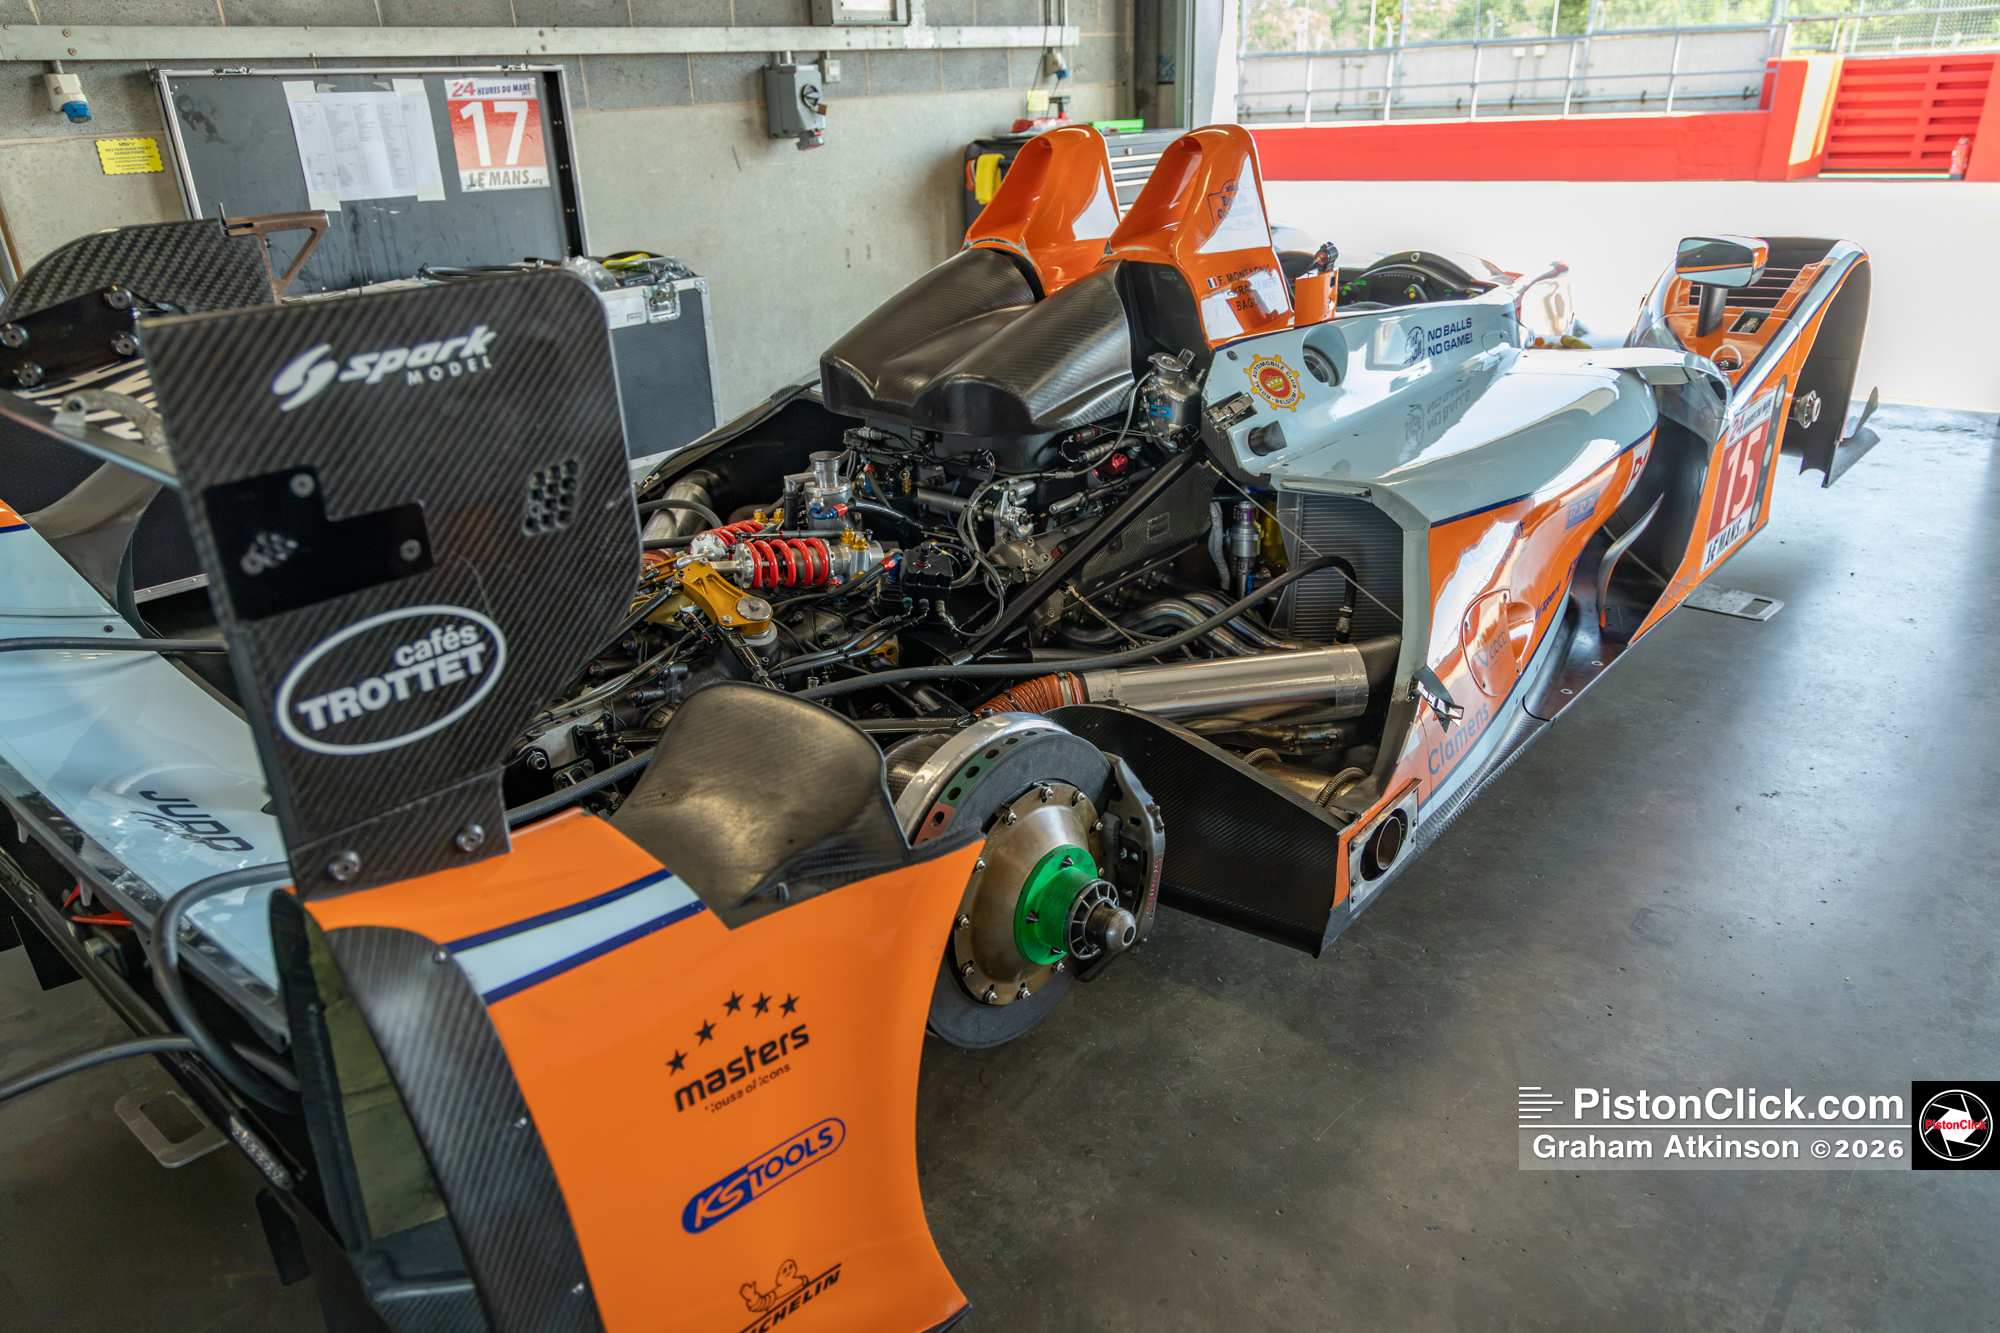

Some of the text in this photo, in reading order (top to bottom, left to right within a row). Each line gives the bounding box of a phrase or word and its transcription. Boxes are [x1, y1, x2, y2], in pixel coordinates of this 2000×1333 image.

[452, 82, 531, 97] 24 HEURES DU MANS
[460, 101, 528, 166] 17
[469, 172, 485, 187] LE
[1218, 264, 1271, 286] F. MONTAGNY
[1427, 317, 1472, 341] NO BALLS
[1427, 343, 1443, 357] NO
[1443, 332, 1473, 352] GAME!
[339, 325, 497, 385] spark
[406, 356, 493, 386] MODEL
[1252, 360, 1285, 379] AUTOMOBILE
[1285, 371, 1297, 389] CLUB
[1729, 411, 1746, 443] 24
[1720, 425, 1763, 530] 15
[395, 624, 480, 667] cafés
[297, 642, 487, 731] TROTTET
[139, 791, 254, 852] JUDD
[674, 1023, 809, 1113] masters
[694, 1126, 834, 1229] KS TOOLS
[750, 1269, 841, 1333] CHELIN
